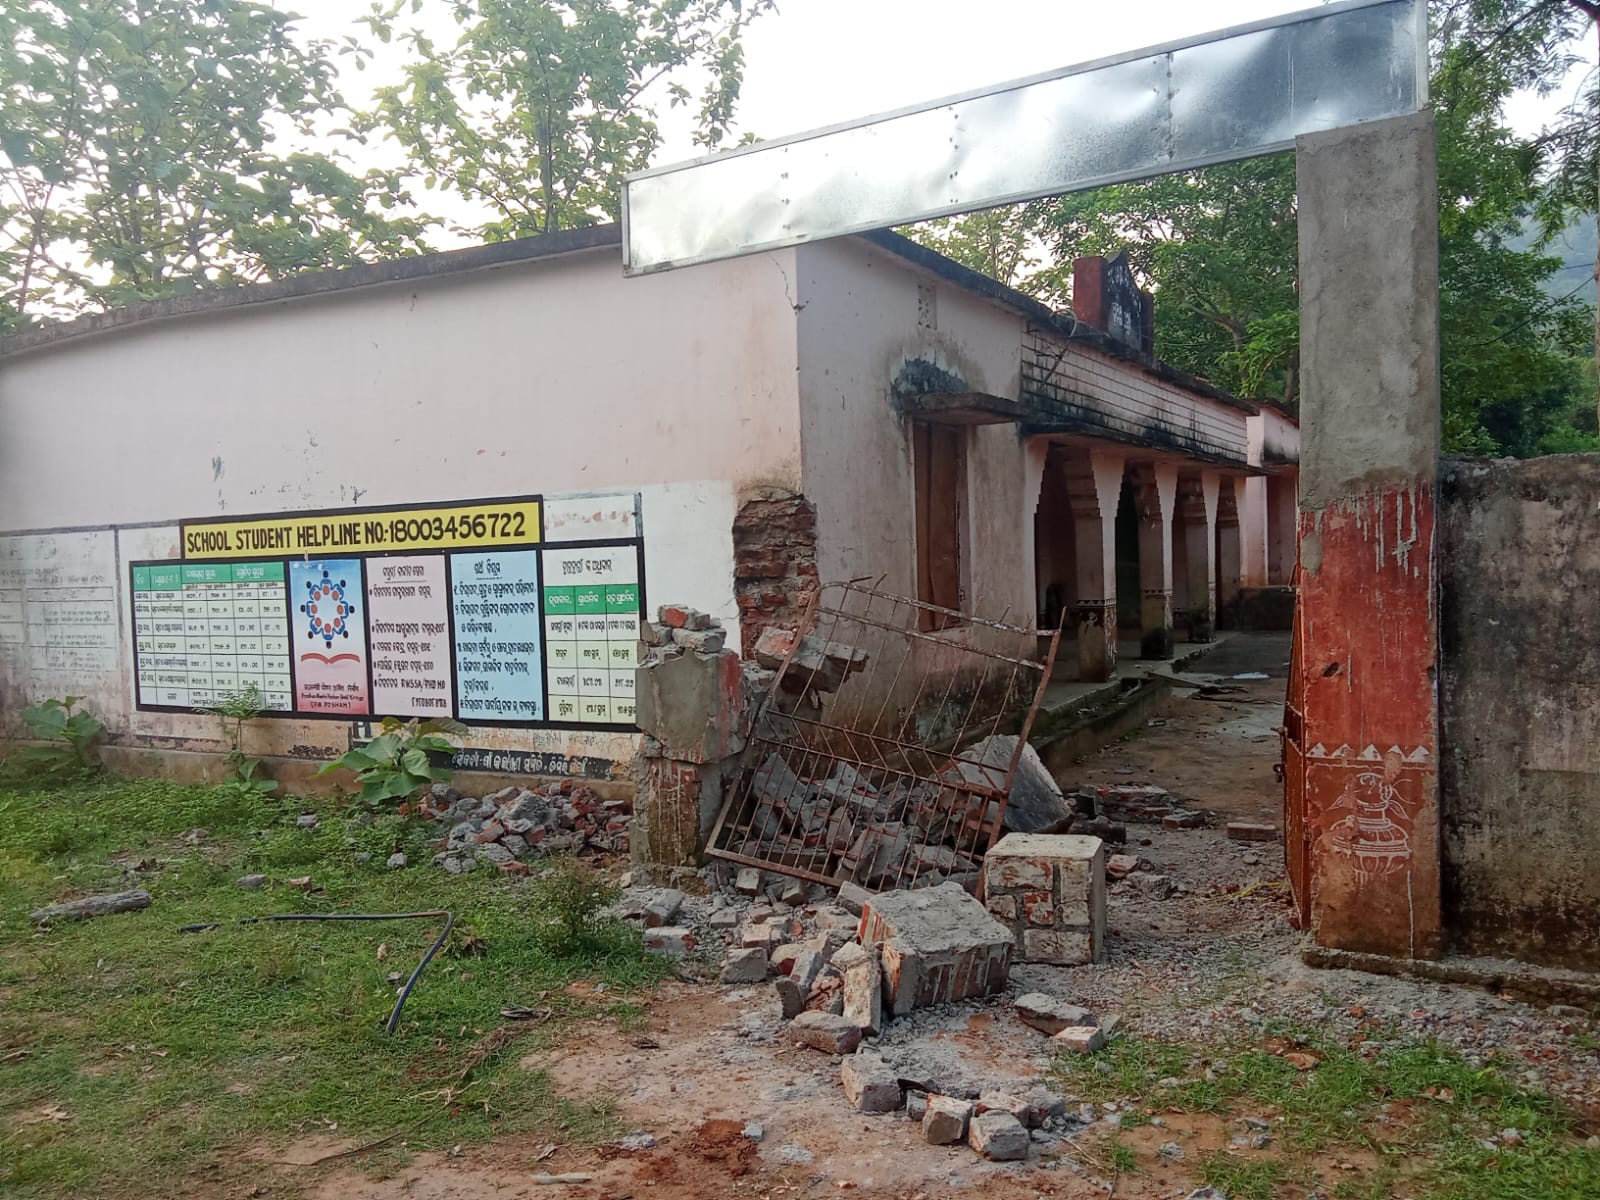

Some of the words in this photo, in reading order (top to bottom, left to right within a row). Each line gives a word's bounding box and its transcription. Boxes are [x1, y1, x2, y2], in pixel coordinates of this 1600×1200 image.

[187, 531, 232, 552] SCHOOL
[236, 527, 293, 550] STUDENT
[297, 522, 361, 547] HELPLINE
